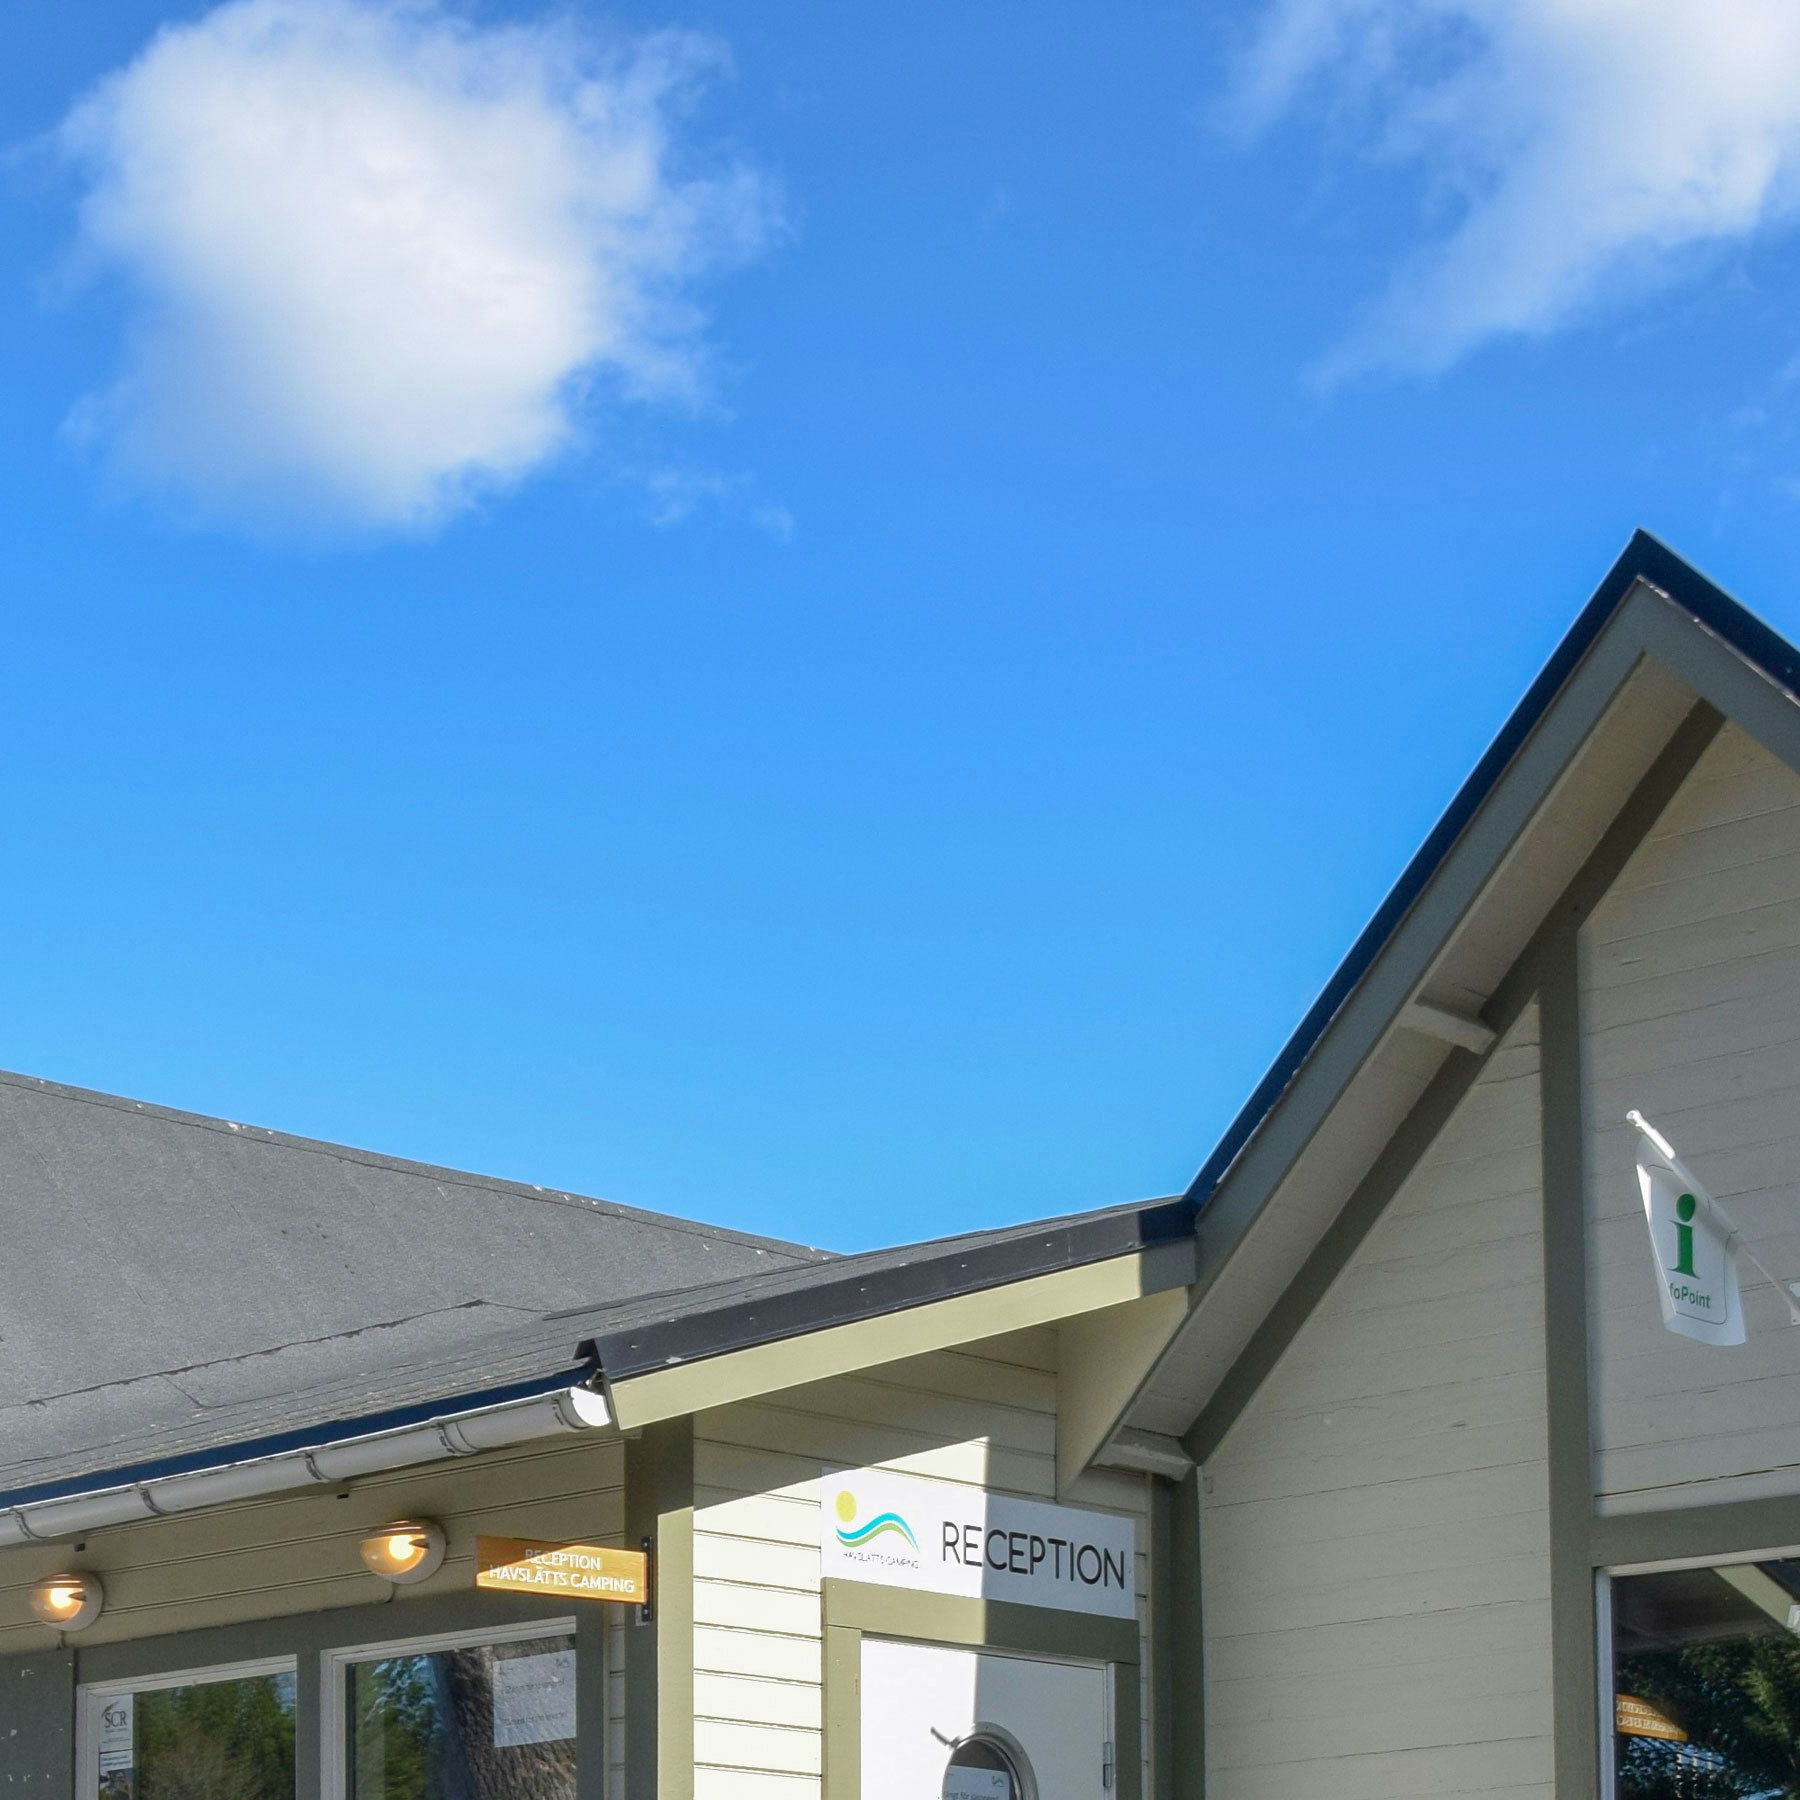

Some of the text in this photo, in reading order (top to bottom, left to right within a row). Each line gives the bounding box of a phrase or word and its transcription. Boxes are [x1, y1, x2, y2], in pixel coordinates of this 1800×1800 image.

[1670, 1282, 1712, 1310] foPoint
[525, 1548, 601, 1571] RECEPTION
[942, 1521, 1125, 1590] RECEPTION
[569, 1573, 636, 1593] CAMPING
[104, 1710, 128, 1729] SCR
